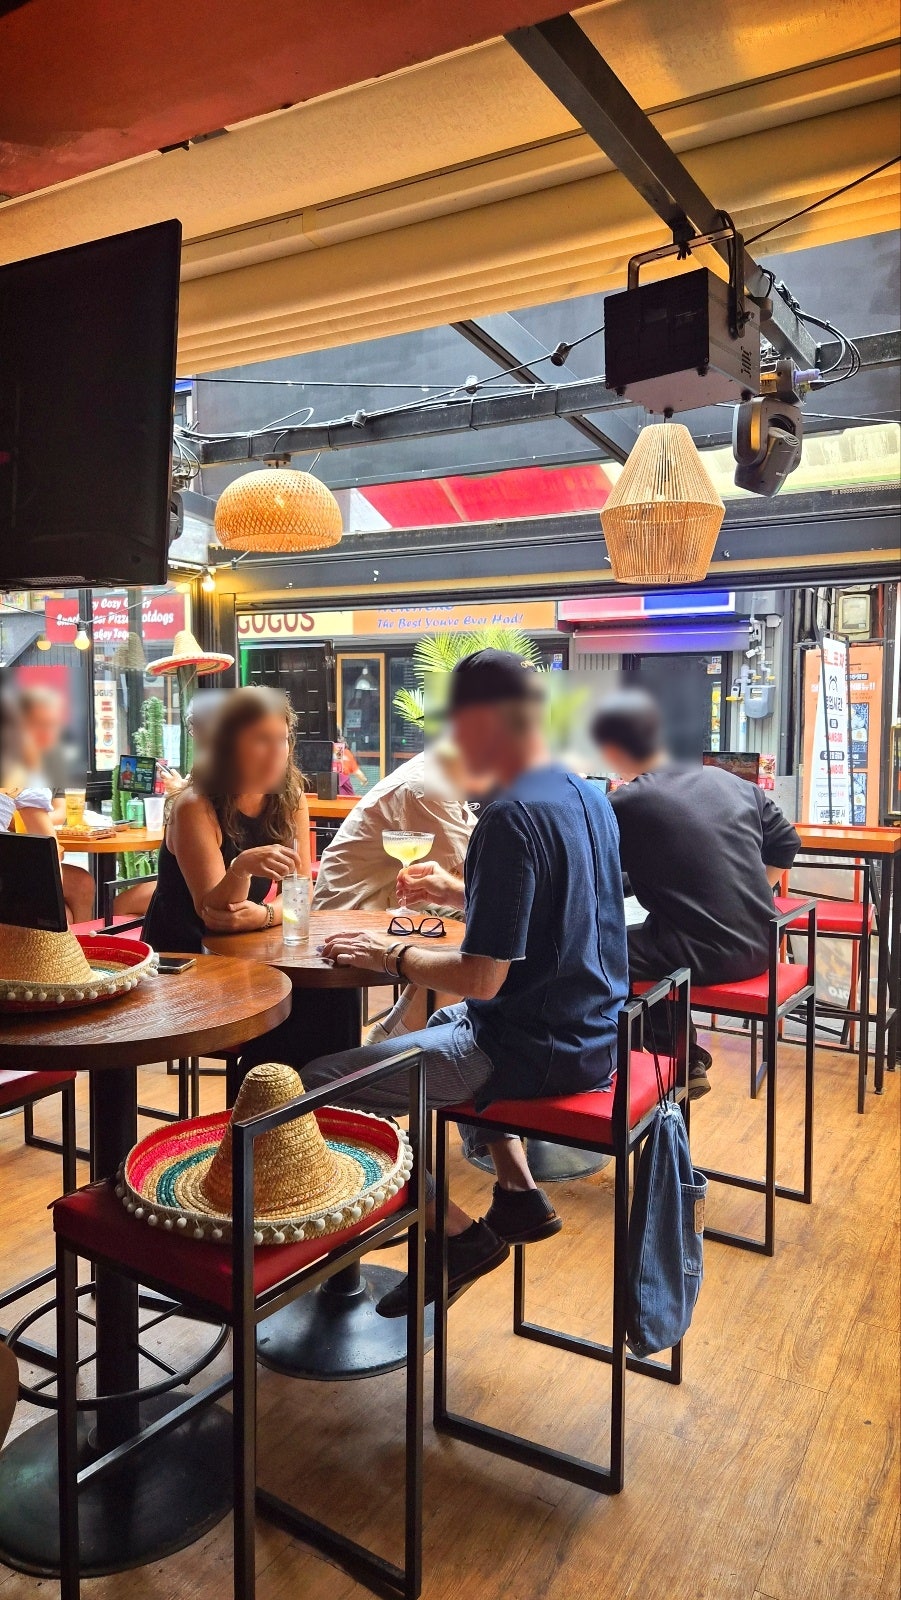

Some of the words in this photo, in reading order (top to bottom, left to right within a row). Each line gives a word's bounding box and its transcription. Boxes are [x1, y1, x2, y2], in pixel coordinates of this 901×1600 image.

[377, 618, 394, 629] The
[398, 617, 422, 629] Best
[463, 615, 487, 626] Ever
[491, 613, 524, 625] Had!
